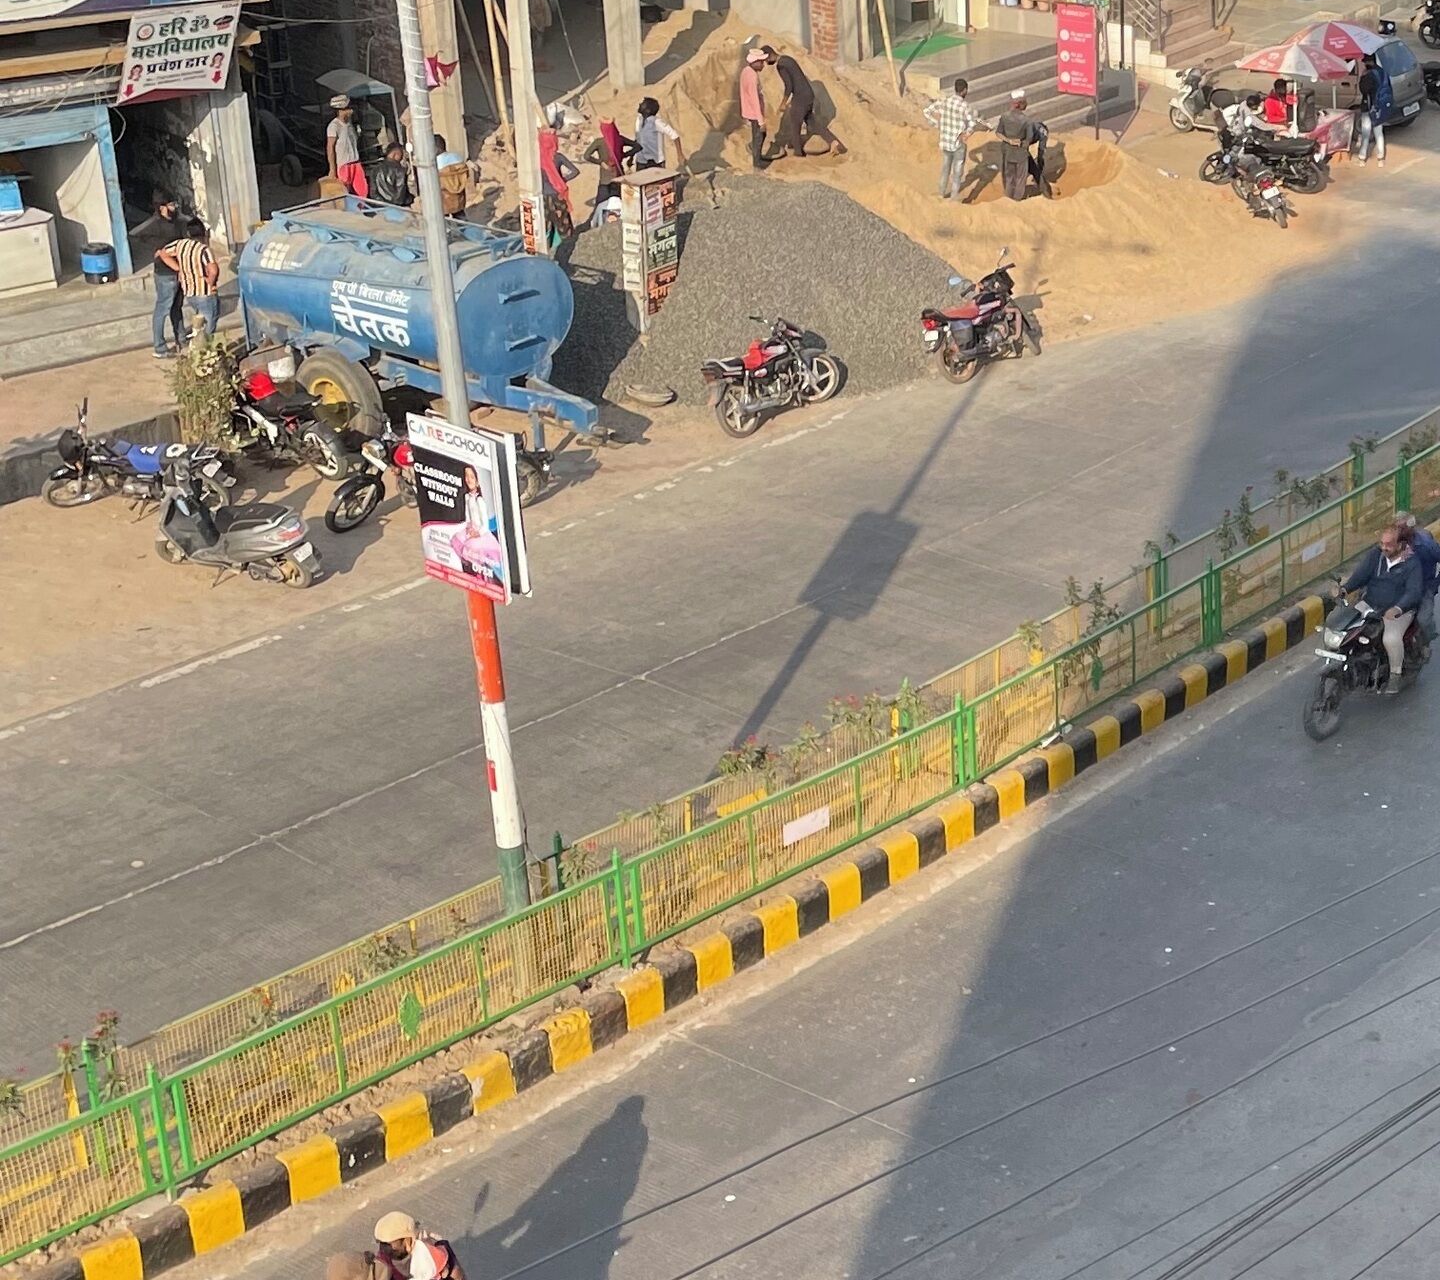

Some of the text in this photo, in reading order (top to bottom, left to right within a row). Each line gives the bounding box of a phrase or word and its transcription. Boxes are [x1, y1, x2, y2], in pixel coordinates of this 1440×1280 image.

[159, 16, 187, 37] हरि
[131, 32, 232, 60] महाविद्यालय
[146, 54, 210, 76] प्रवेश द्वार
[331, 294, 411, 348] चेतक
[408, 419, 490, 458] CARE SCHOOL
[413, 461, 463, 488] CLASSROOM
[420, 476, 459, 498] WITHOUT
[427, 490, 455, 509] WALLS
